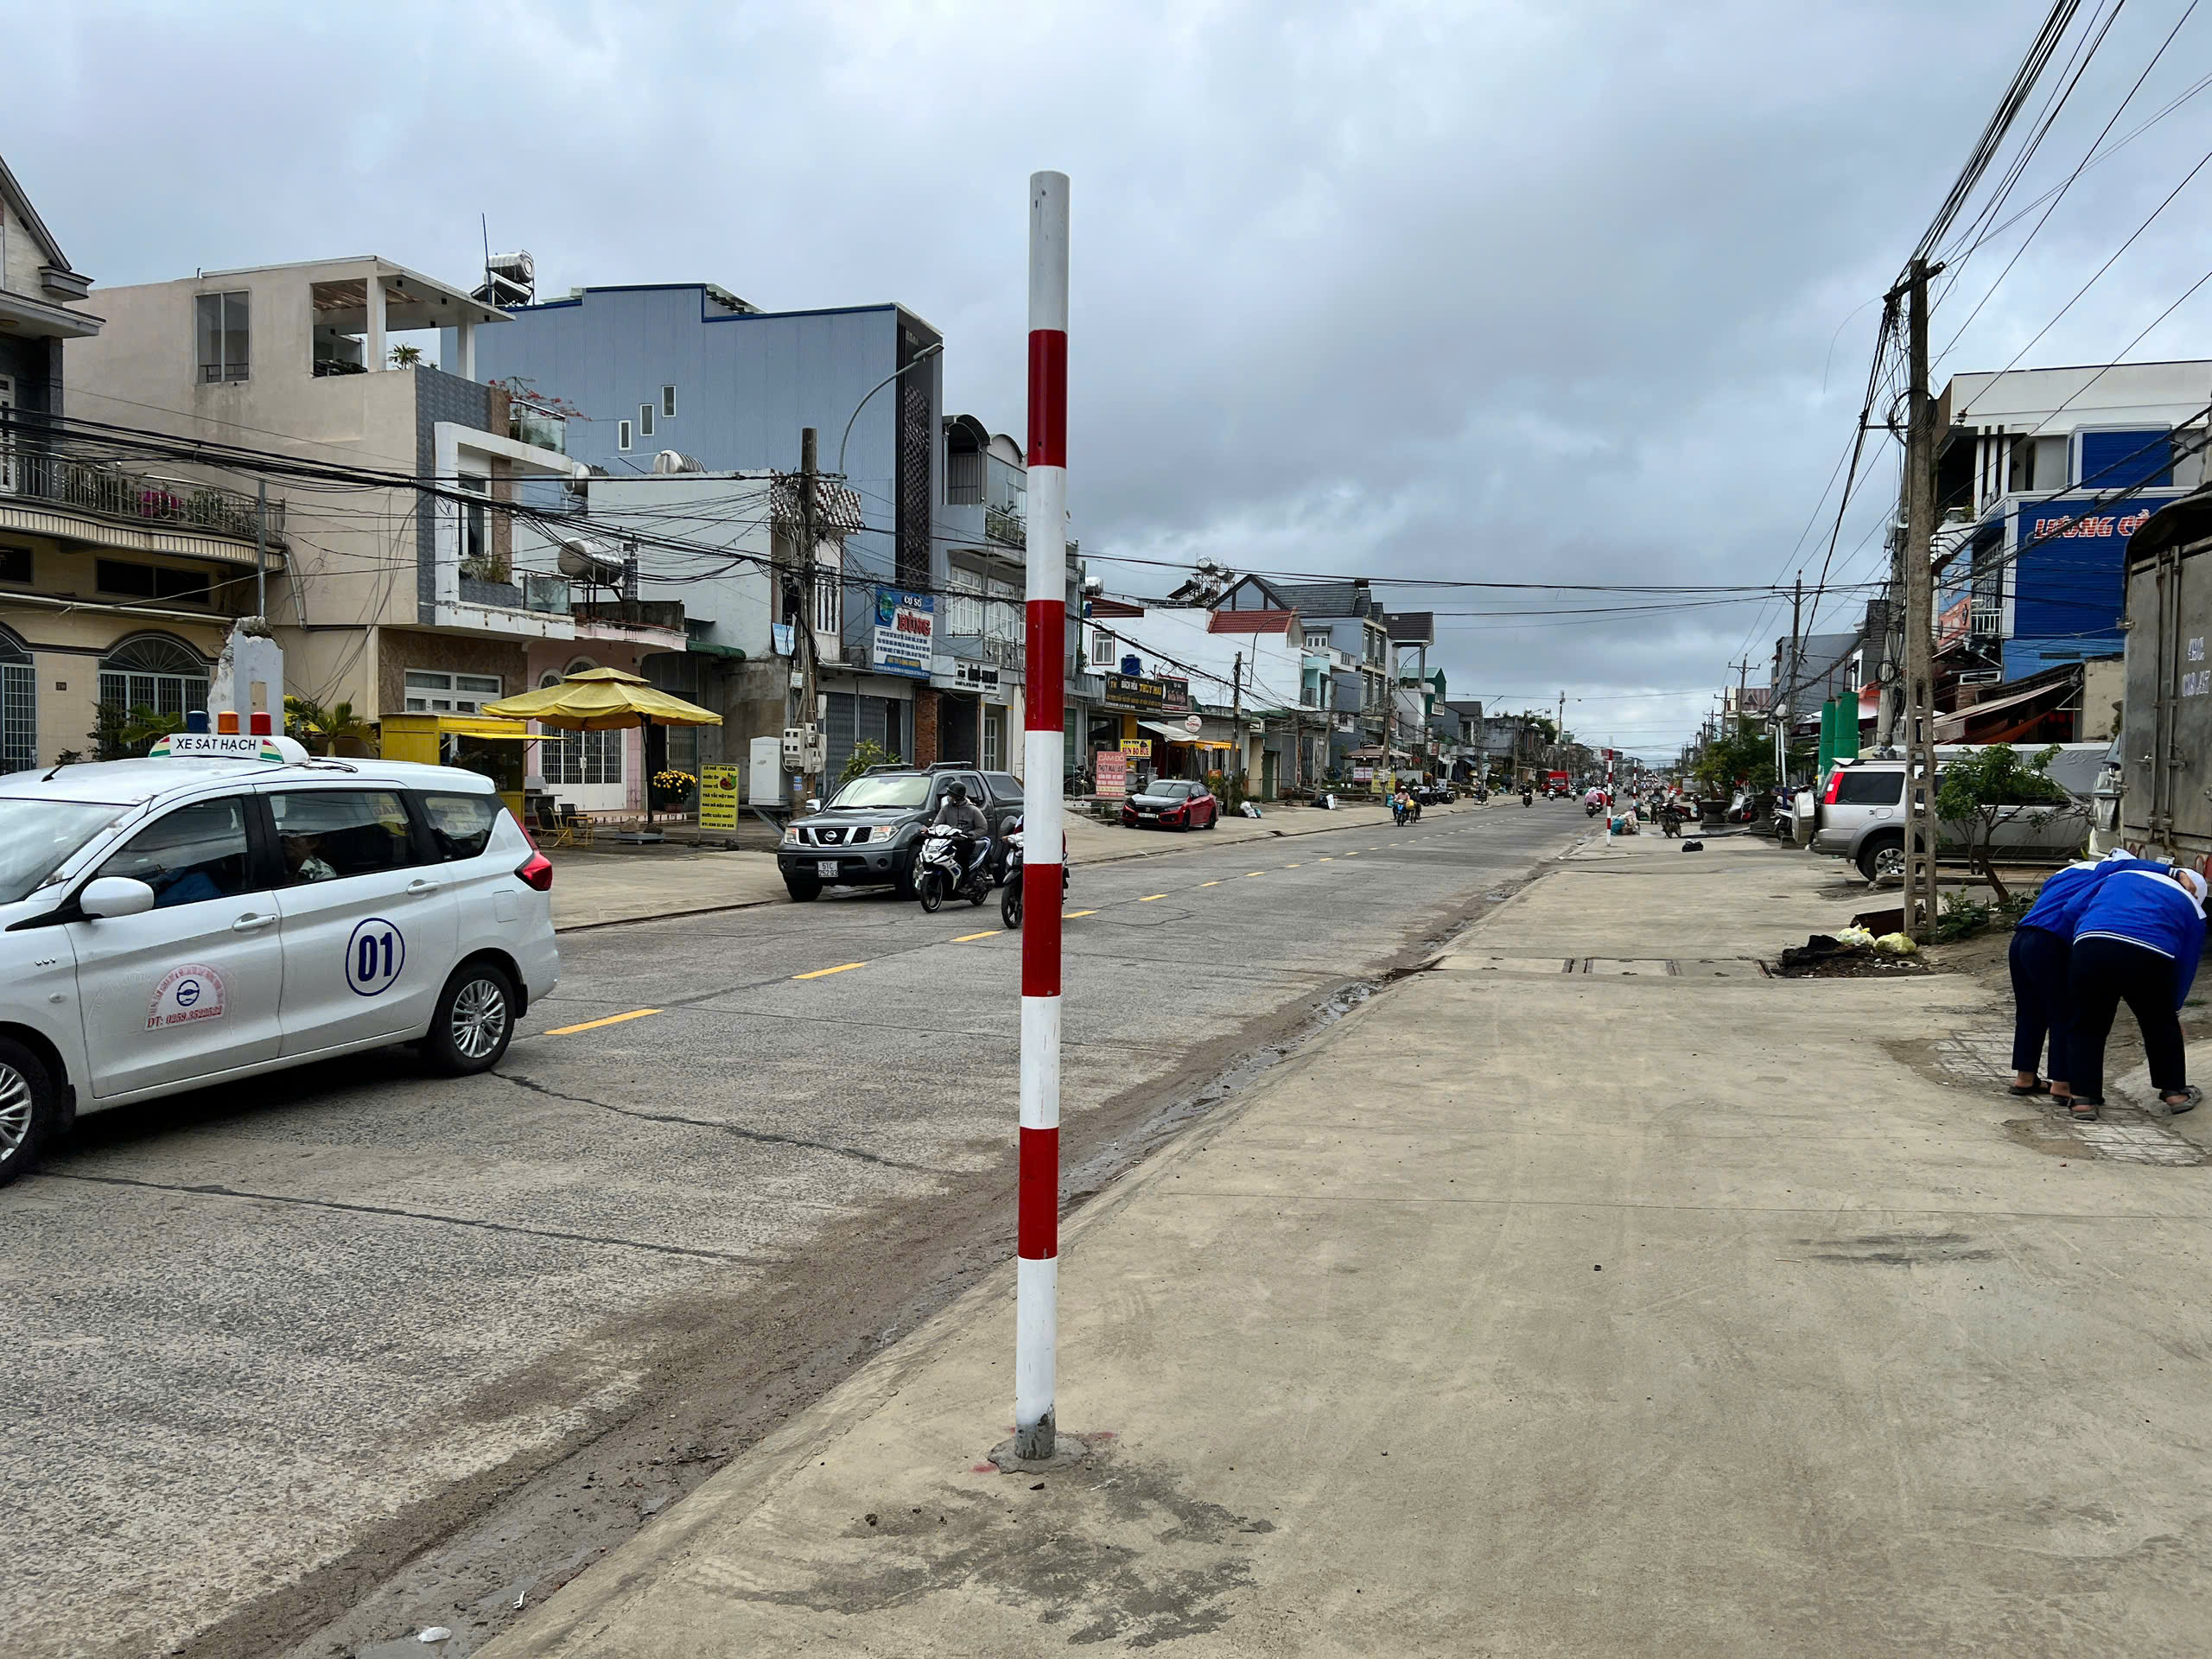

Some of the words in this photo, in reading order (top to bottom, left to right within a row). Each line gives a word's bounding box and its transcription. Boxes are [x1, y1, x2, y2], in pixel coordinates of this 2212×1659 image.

[176, 739, 192, 749] XE
[195, 735, 218, 749] SÁT
[220, 739, 257, 753] HẠCH
[358, 931, 392, 982] 01
